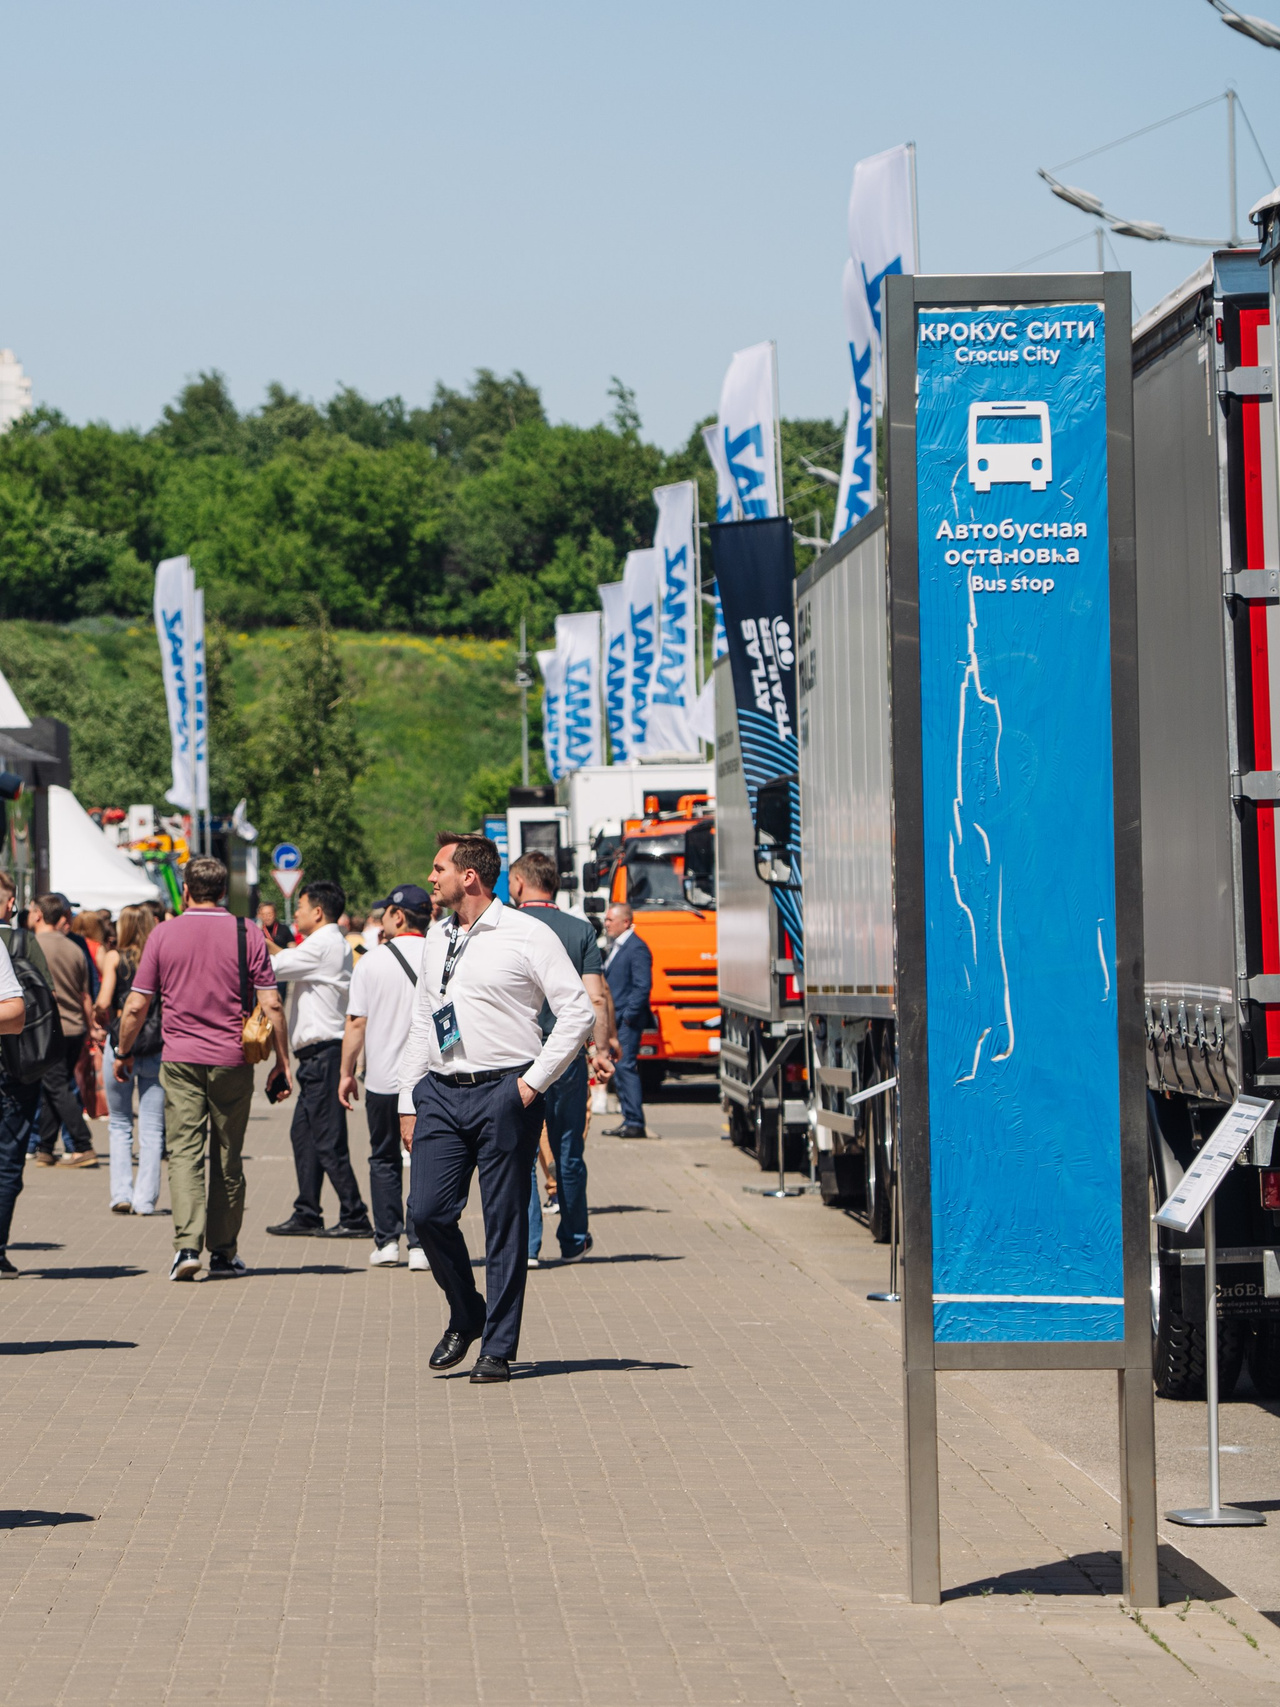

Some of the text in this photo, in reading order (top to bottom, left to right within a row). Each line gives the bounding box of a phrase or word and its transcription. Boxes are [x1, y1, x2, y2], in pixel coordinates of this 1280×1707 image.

[920, 320, 1095, 342] КРОКУС СИТИ
[955, 345, 1061, 365] Crocus City
[935, 518, 1088, 544] Автобусная
[944, 547, 1080, 566] остановка
[971, 575, 1055, 595] Bus stop
[652, 544, 687, 707] KAMAZ
[740, 618, 773, 714] ATLAS
[758, 616, 793, 742] TRAILER
